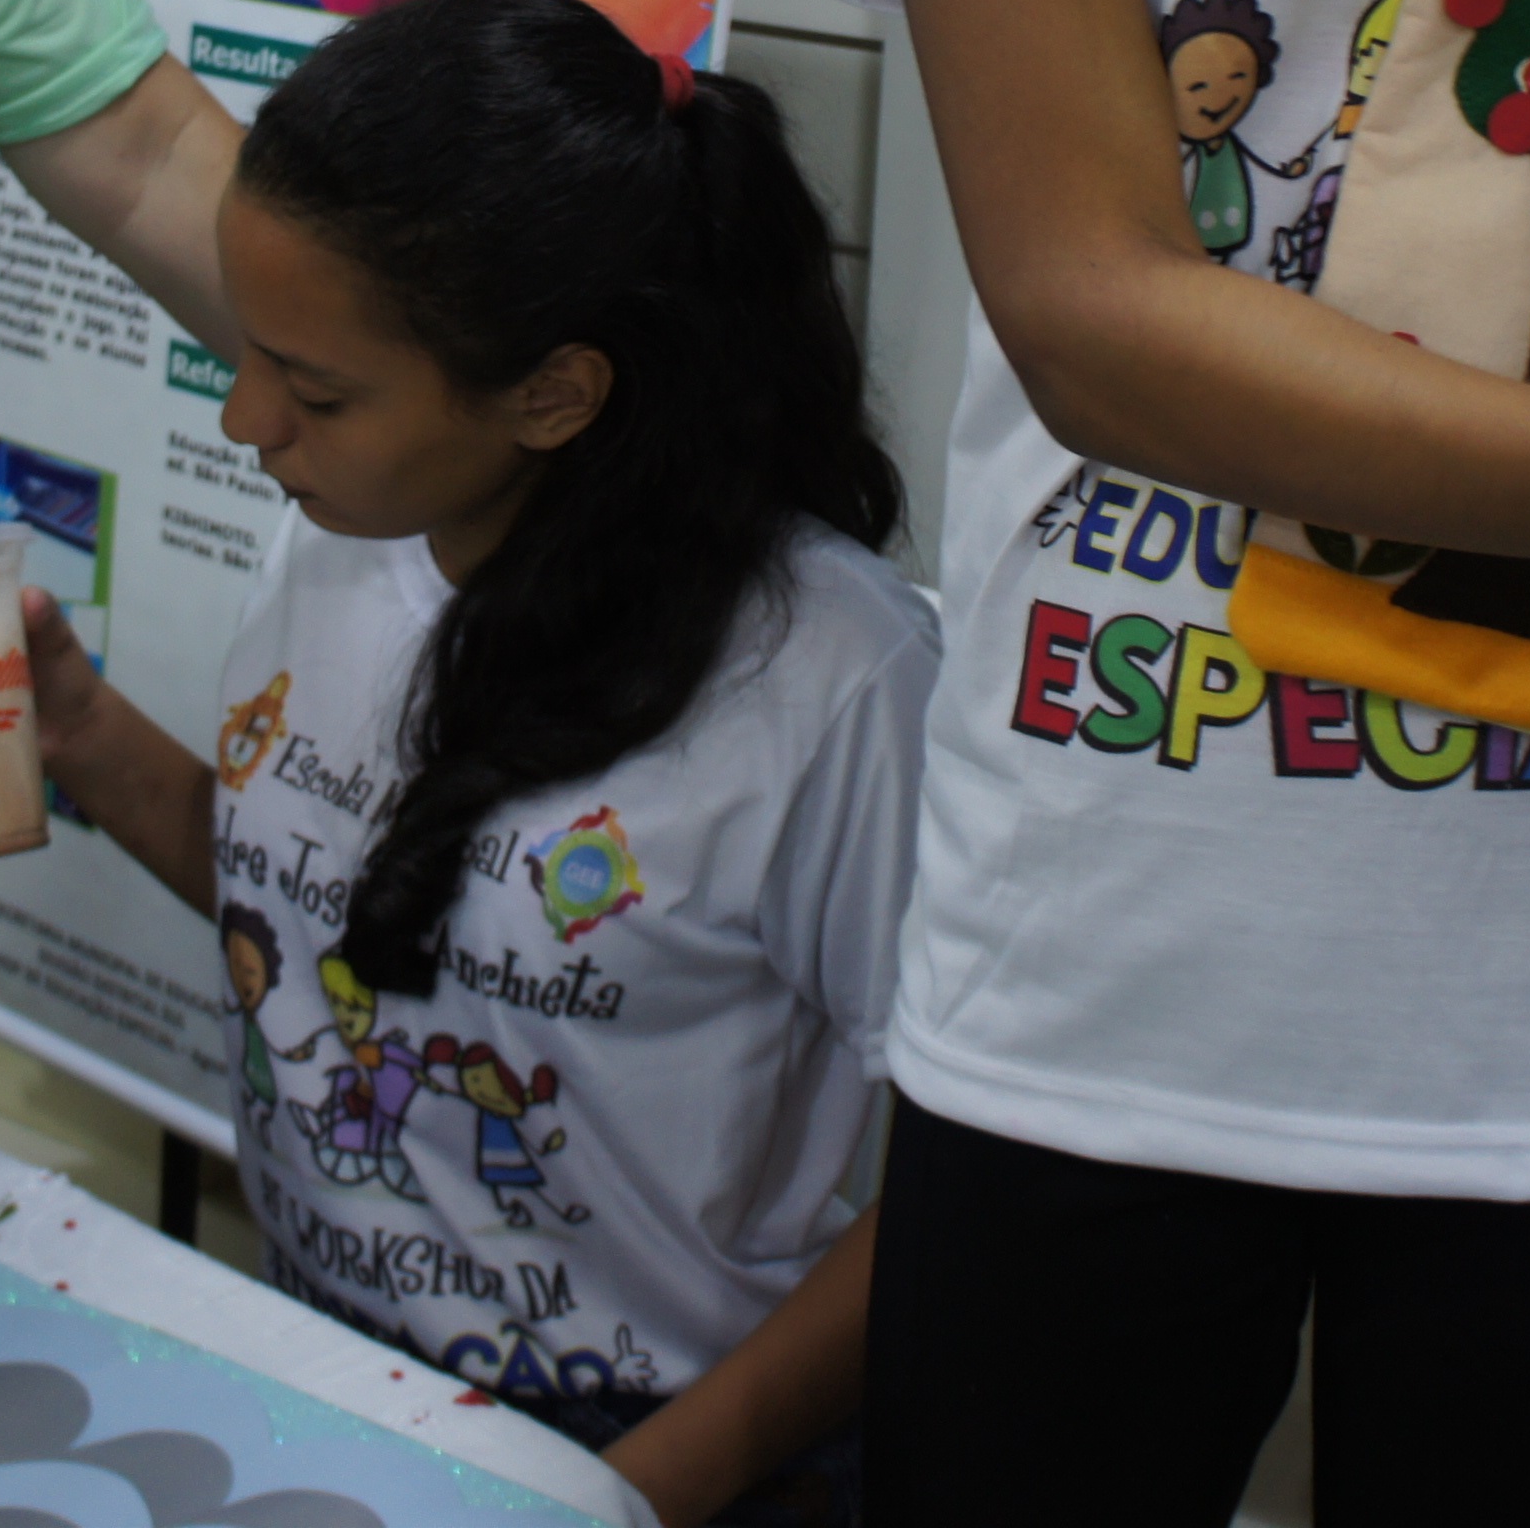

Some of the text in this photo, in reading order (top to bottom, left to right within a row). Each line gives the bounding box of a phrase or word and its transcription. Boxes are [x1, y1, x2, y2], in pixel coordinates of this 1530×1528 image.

[272, 733, 376, 819] Escola
[278, 829, 352, 928] Jos
[519, 1261, 579, 1323] DA
